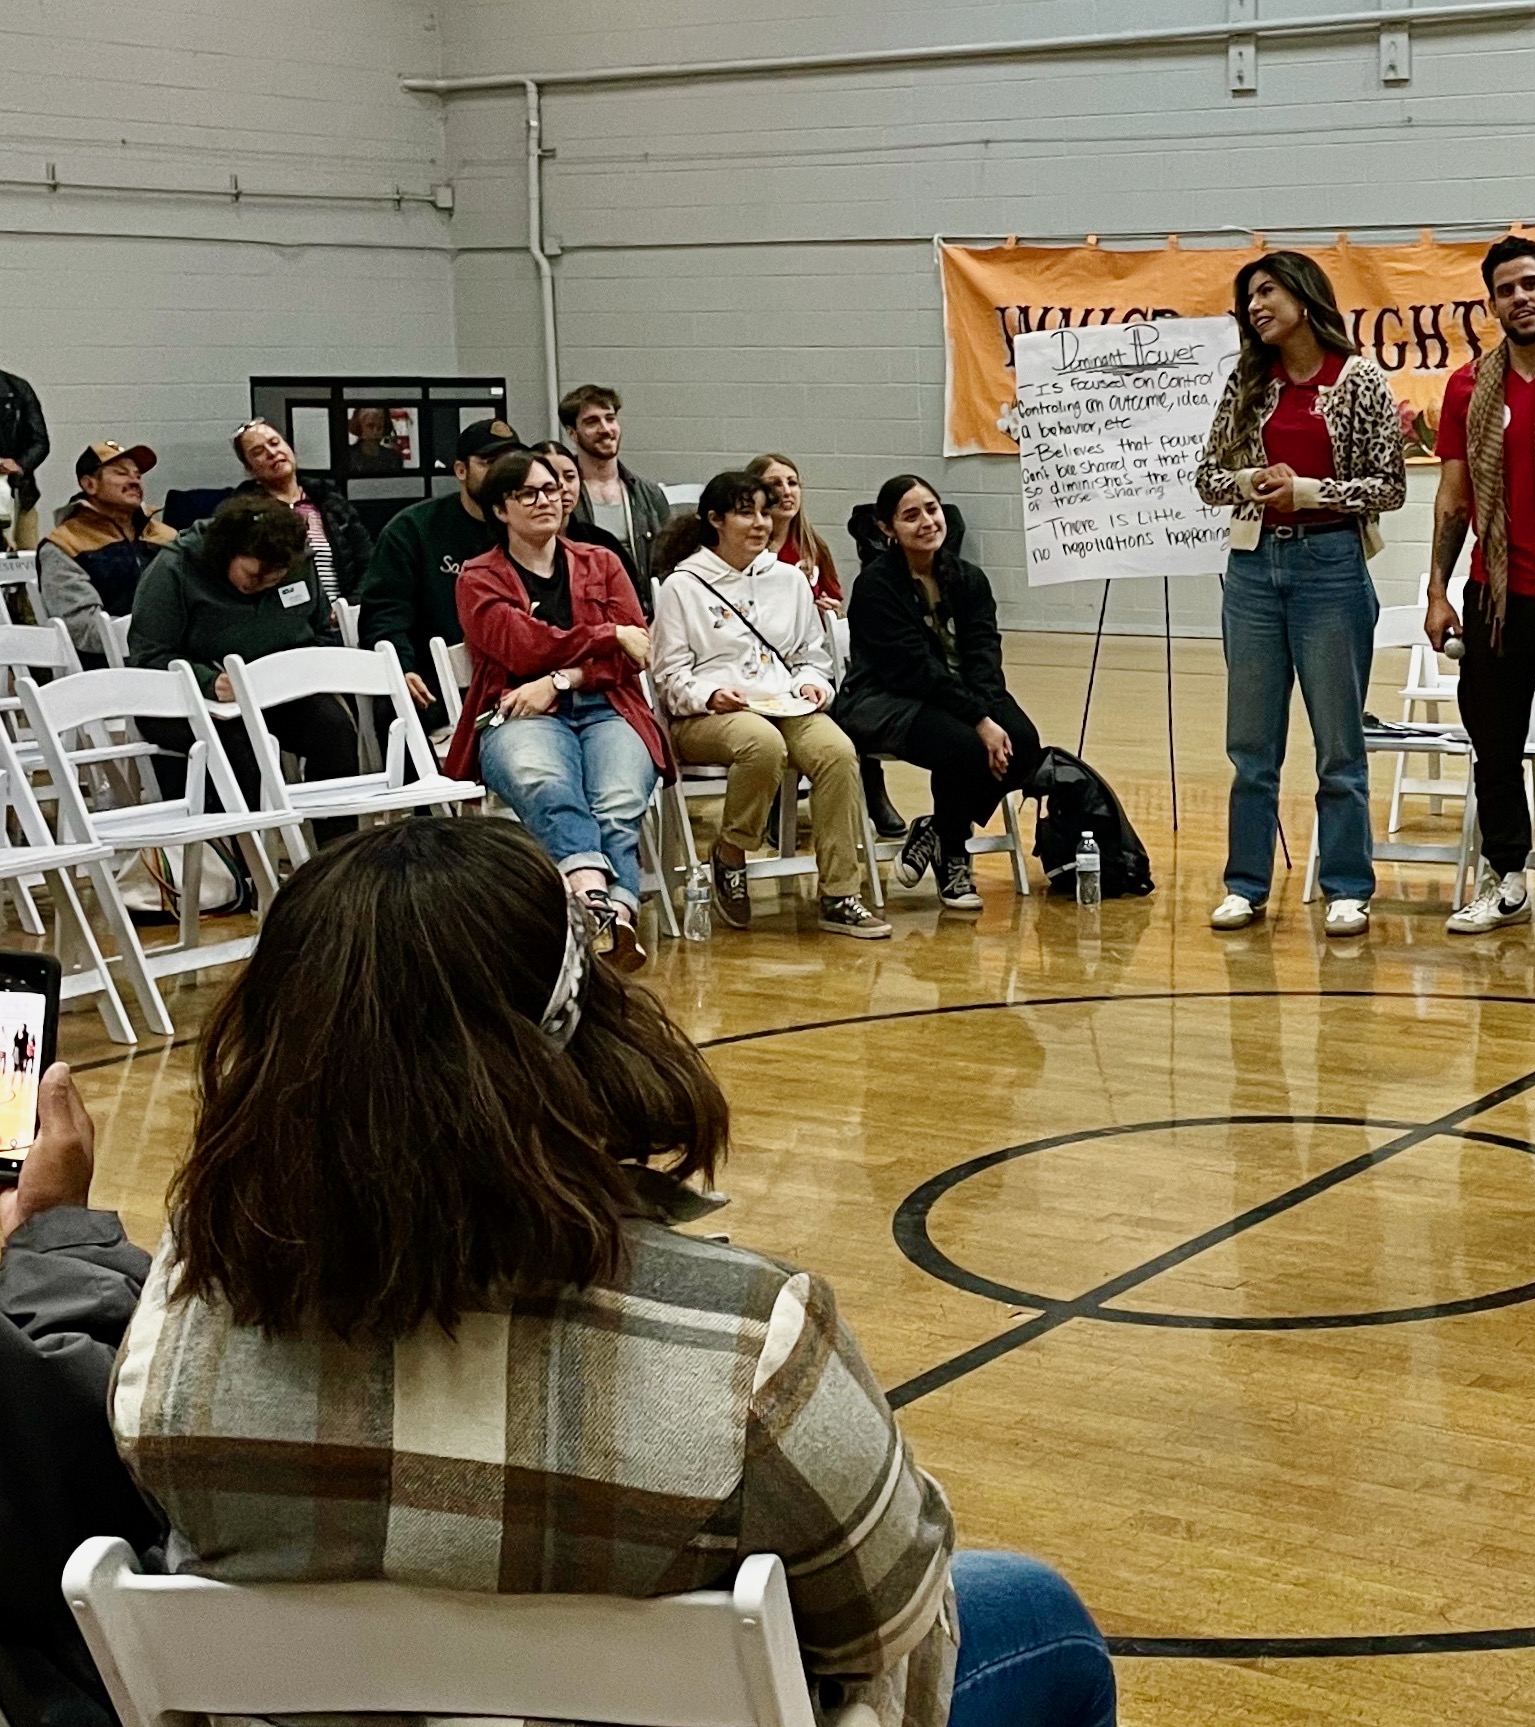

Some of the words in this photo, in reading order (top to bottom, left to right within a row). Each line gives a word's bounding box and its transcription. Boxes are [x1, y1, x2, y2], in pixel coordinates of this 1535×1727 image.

[1349, 299, 1487, 371] IGHT
[1050, 330, 1127, 372] Dominant
[1123, 323, 1204, 366] Power
[1133, 376, 1155, 391] on
[1085, 398, 1104, 413] an
[1021, 425, 1031, 440] a
[1104, 415, 1132, 430] etc
[1118, 435, 1152, 453] that
[1133, 457, 1148, 469] or
[1157, 452, 1189, 468] that
[1050, 474, 1133, 495] diminishes
[1147, 470, 1171, 486] the
[1028, 498, 1039, 512] of
[1052, 492, 1091, 509] those
[1104, 485, 1165, 501] sharing
[1196, 505, 1221, 520] to
[440, 555, 461, 575] Sa
[1032, 548, 1050, 564] no
